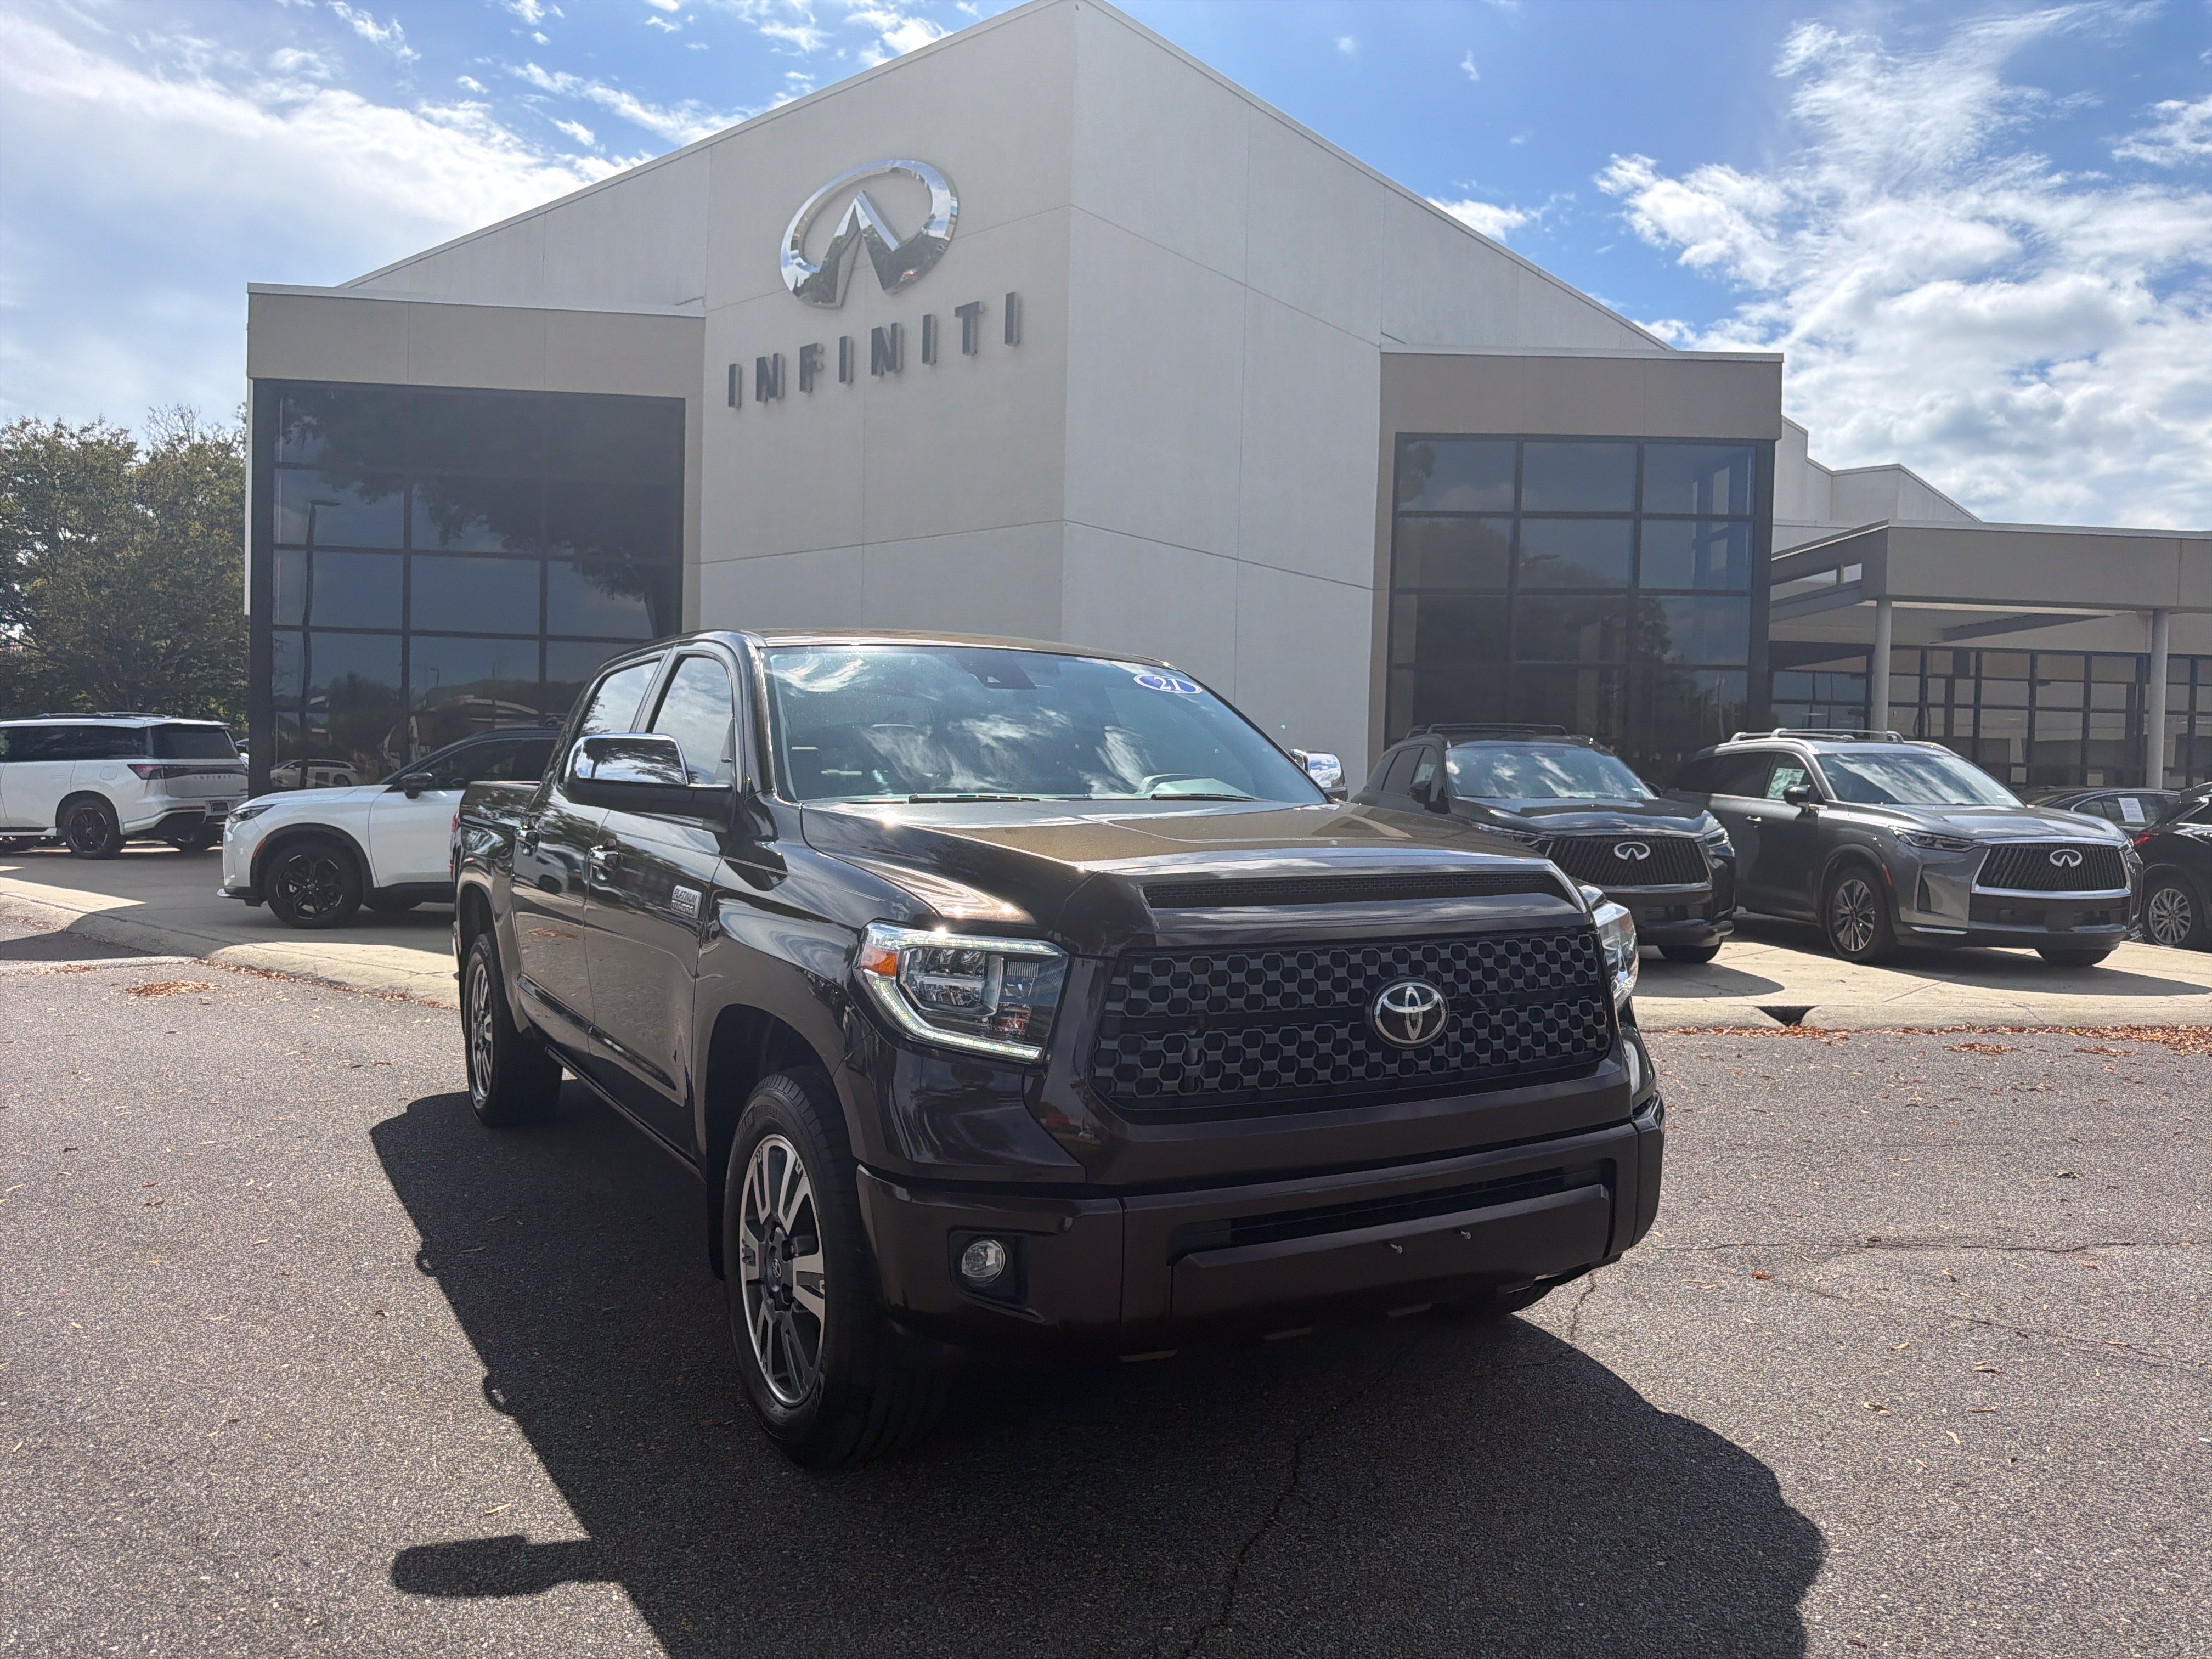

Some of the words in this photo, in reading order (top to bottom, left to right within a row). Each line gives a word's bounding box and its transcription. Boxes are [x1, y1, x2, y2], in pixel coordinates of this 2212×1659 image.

[728, 292, 1020, 408] INFINITI
[1154, 677, 1184, 691] 21
[674, 889, 697, 903] PLATINUM
